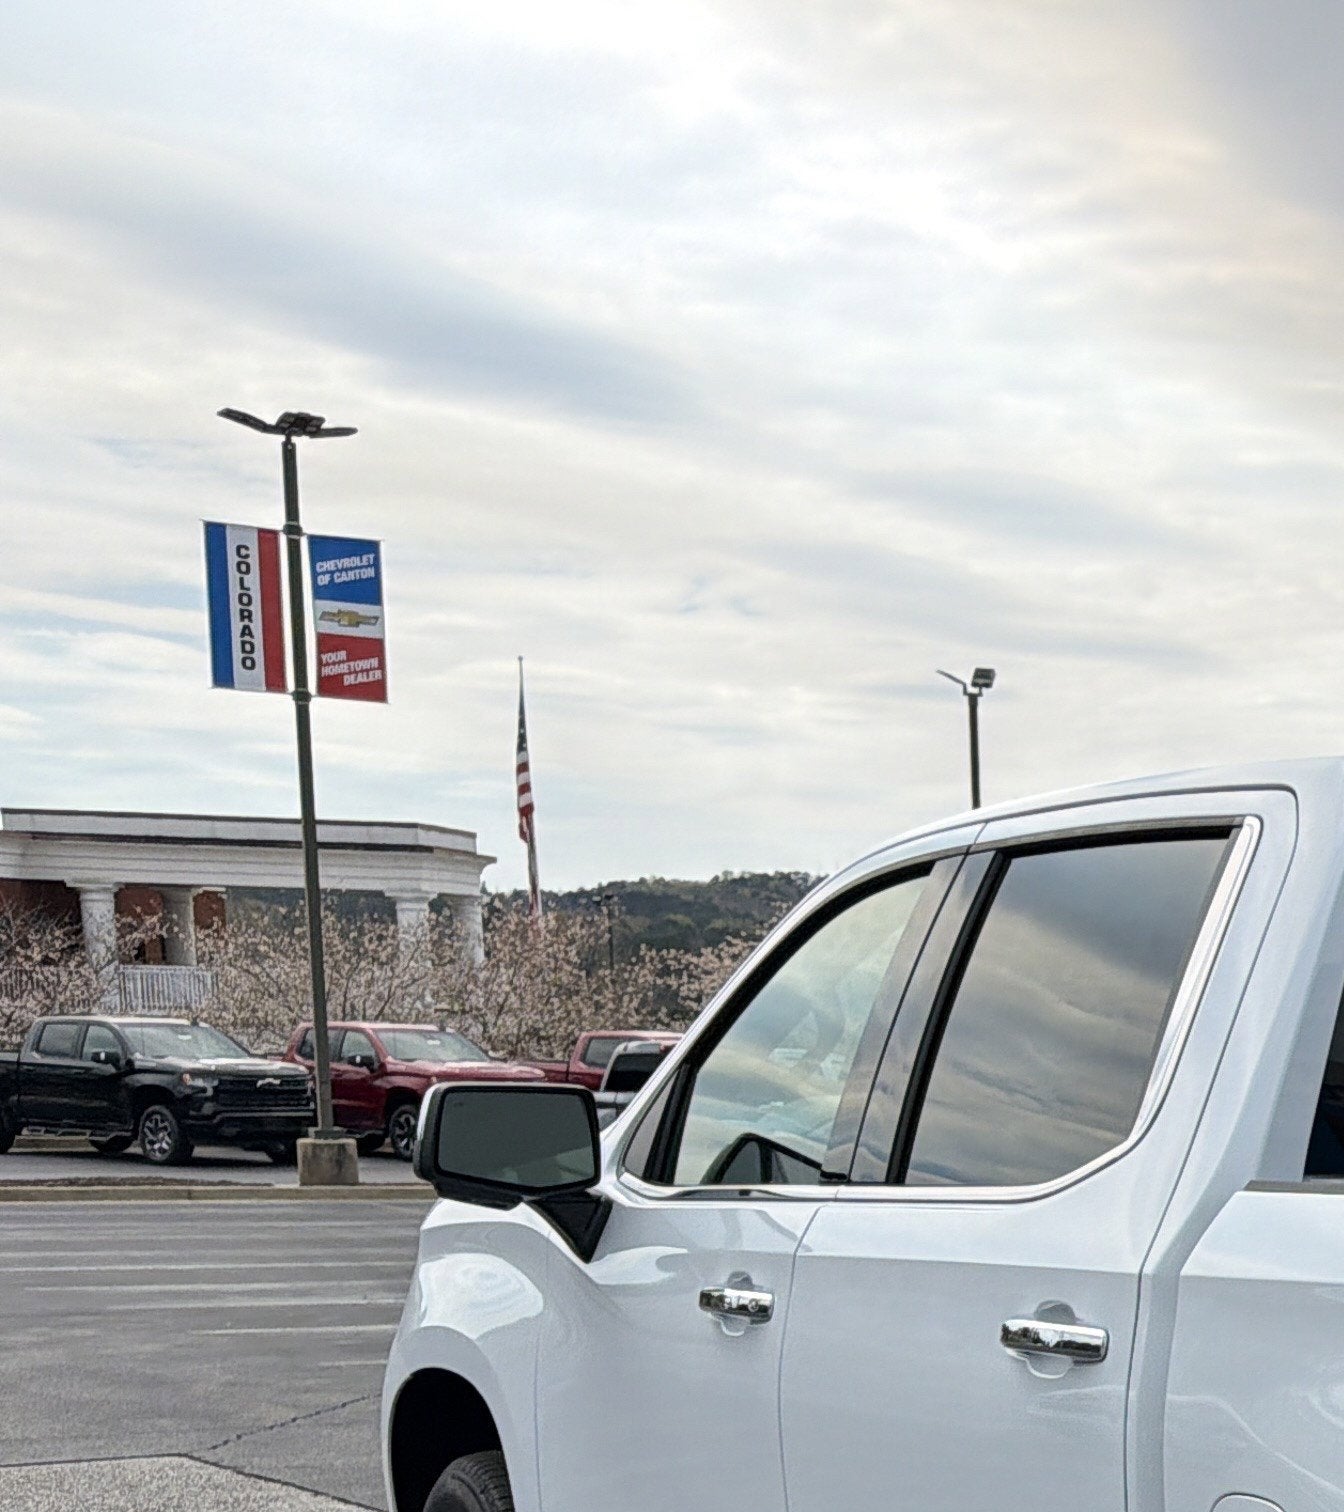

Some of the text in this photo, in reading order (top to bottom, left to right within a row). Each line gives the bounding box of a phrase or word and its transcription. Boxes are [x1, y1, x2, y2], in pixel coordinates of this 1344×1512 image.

[315, 553, 376, 573] CHEVROLET
[317, 566, 375, 586] OF CANTON
[236, 545, 256, 670] COLORADO
[320, 650, 347, 664] YOUR
[321, 657, 379, 677] HOMETOWN
[343, 669, 383, 686] DEALER
